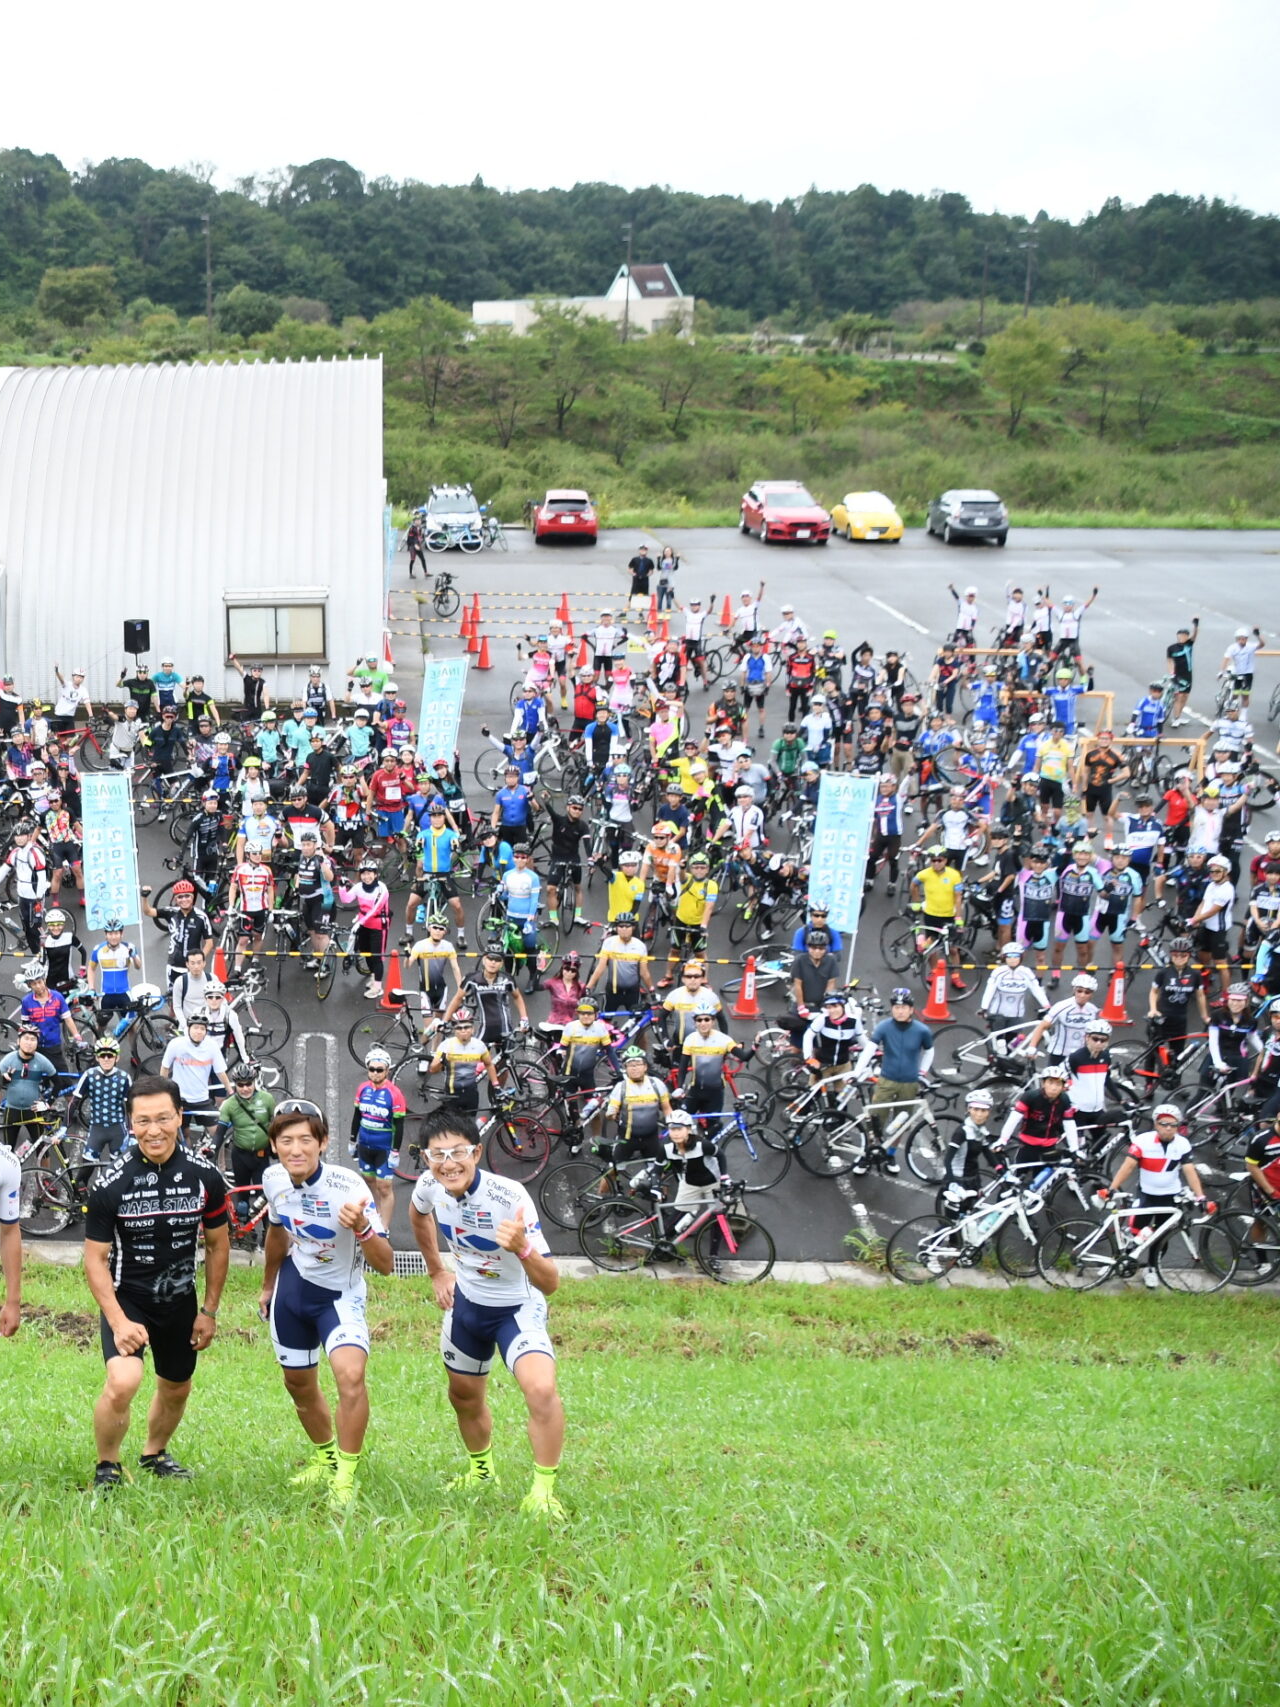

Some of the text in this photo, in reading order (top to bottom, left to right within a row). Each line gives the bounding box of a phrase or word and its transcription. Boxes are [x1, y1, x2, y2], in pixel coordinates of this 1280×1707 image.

[486, 1178, 521, 1202] Champion
[486, 1189, 511, 1210] System
[124, 1219, 155, 1228] DENSO
